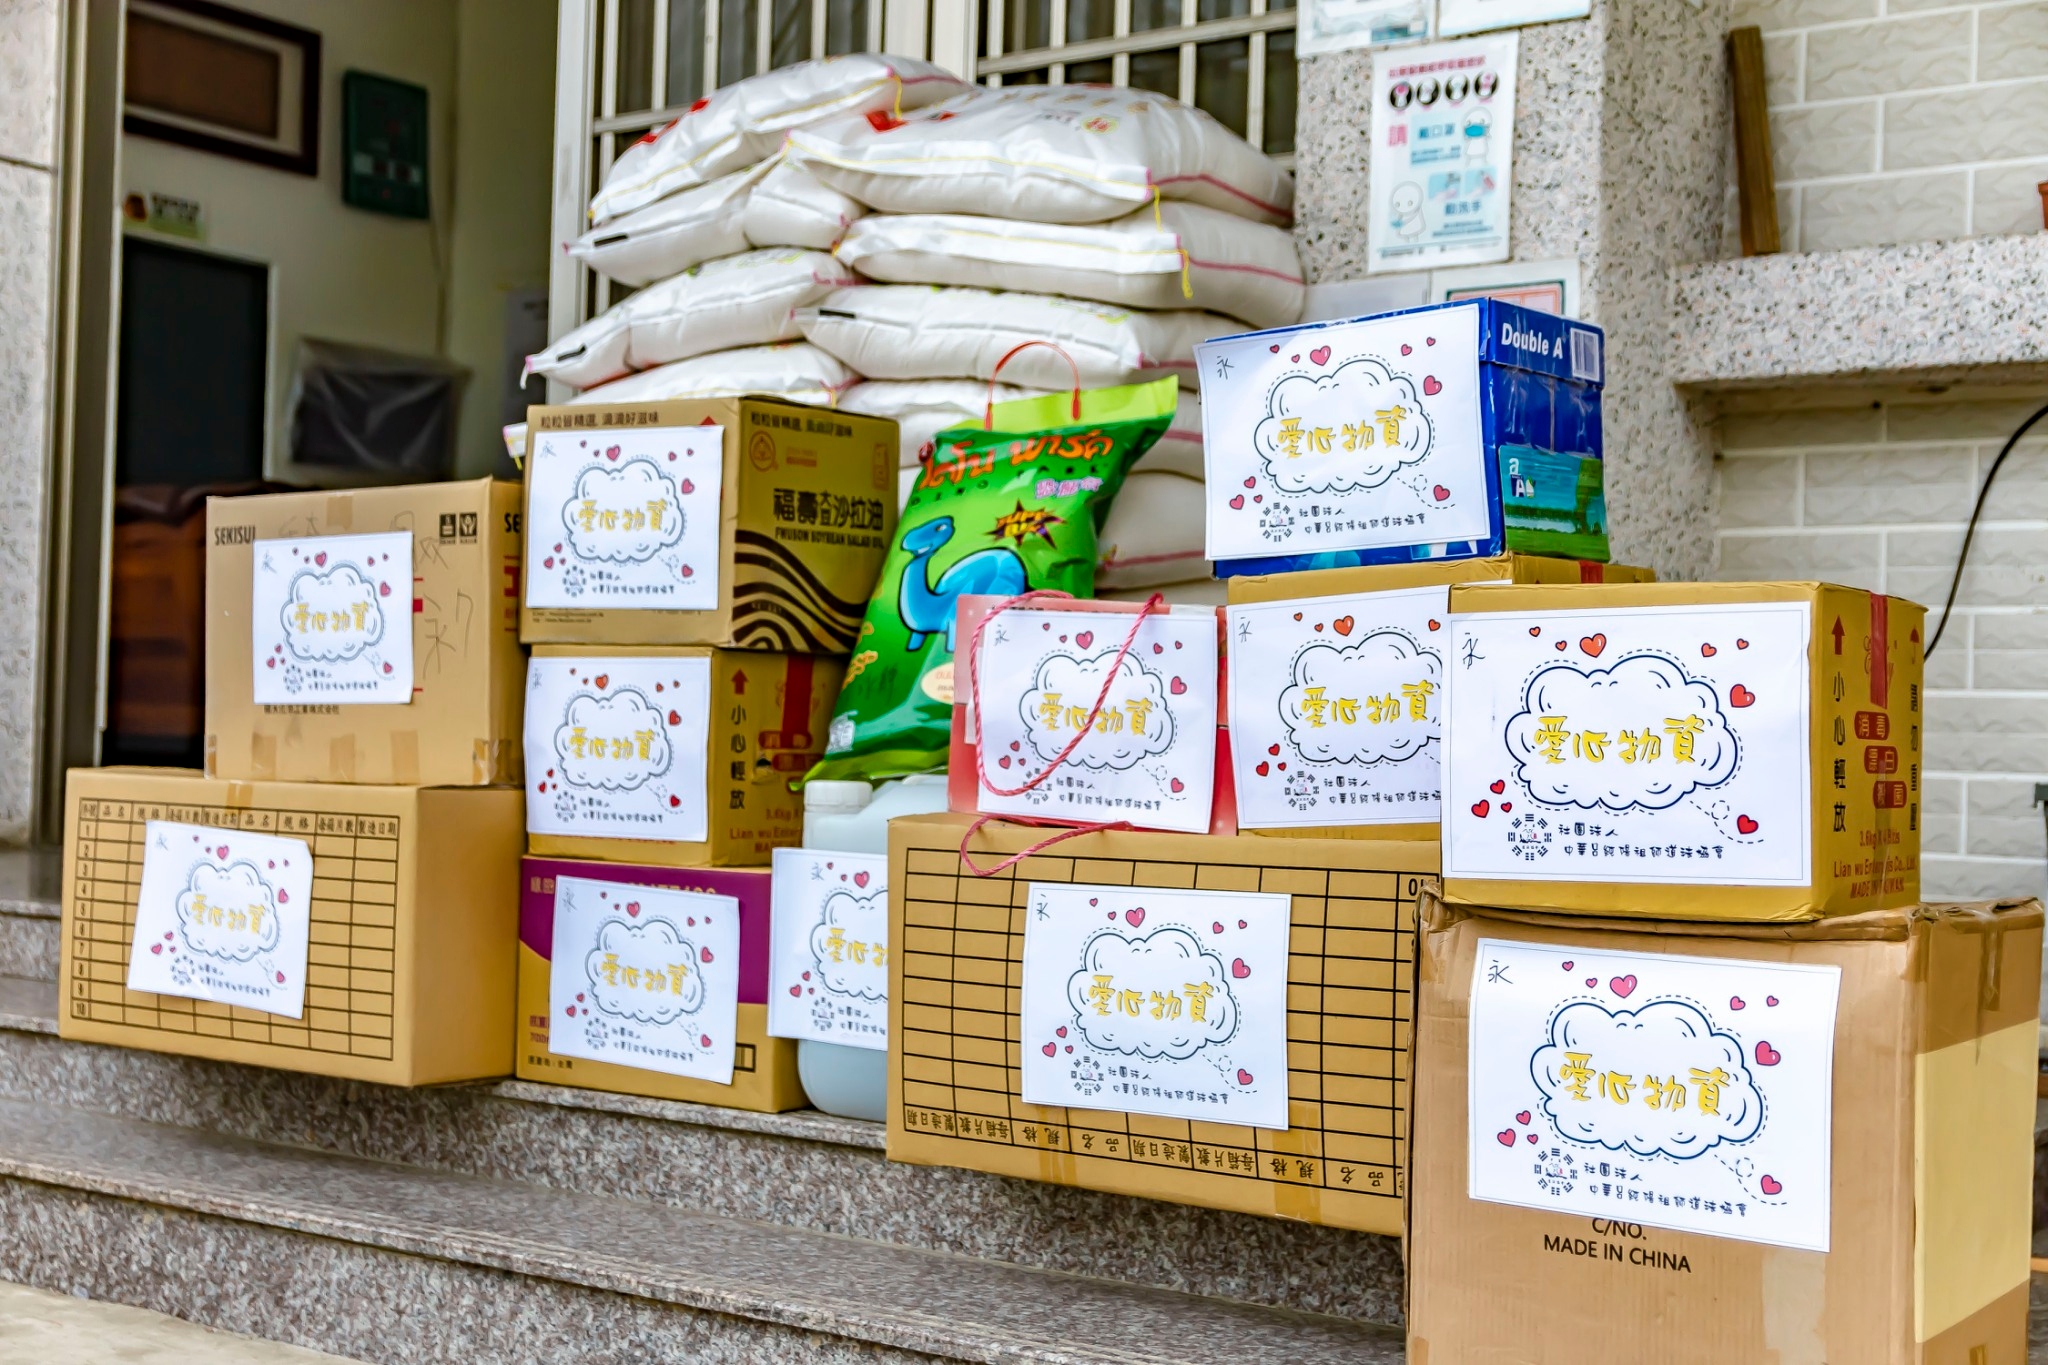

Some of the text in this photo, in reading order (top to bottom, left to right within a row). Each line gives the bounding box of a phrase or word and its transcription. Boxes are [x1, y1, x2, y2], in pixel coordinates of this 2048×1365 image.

[1501, 322, 1564, 360] Double A
[1277, 404, 1408, 460] 愛心物資
[577, 498, 668, 533] 愛心物資
[293, 600, 370, 634] 愛心物資
[1038, 692, 1154, 736] 愛心物資
[1301, 679, 1435, 729] 愛心物資
[569, 727, 656, 762] 愛心物資
[1533, 714, 1706, 765] 愛心物資
[1833, 671, 1847, 832] 小心輕放
[1557, 821, 1619, 838] 社團法人
[1833, 860, 1852, 878] Lian
[190, 892, 267, 935] 愛心物資
[600, 953, 690, 997] 愛心物資
[1487, 959, 1514, 985] 永
[1089, 974, 1215, 1023] 愛心物資
[1559, 1051, 1732, 1117] 愛心物資
[906, 1108, 955, 1133] 製造日期
[958, 1115, 1011, 1140] 每箱片數
[1022, 1124, 1061, 1147] 規格
[1081, 1132, 1120, 1153] 品名
[1132, 1138, 1191, 1165] 製造日期
[1196, 1146, 1256, 1173] 每箱片數
[1269, 1157, 1315, 1180] 規格
[1340, 1165, 1385, 1188] 品名
[1583, 1161, 1644, 1182] 社團法人
[1591, 1217, 1648, 1241] C/NO.
[1543, 1234, 1692, 1273] MADE IN CHINA
